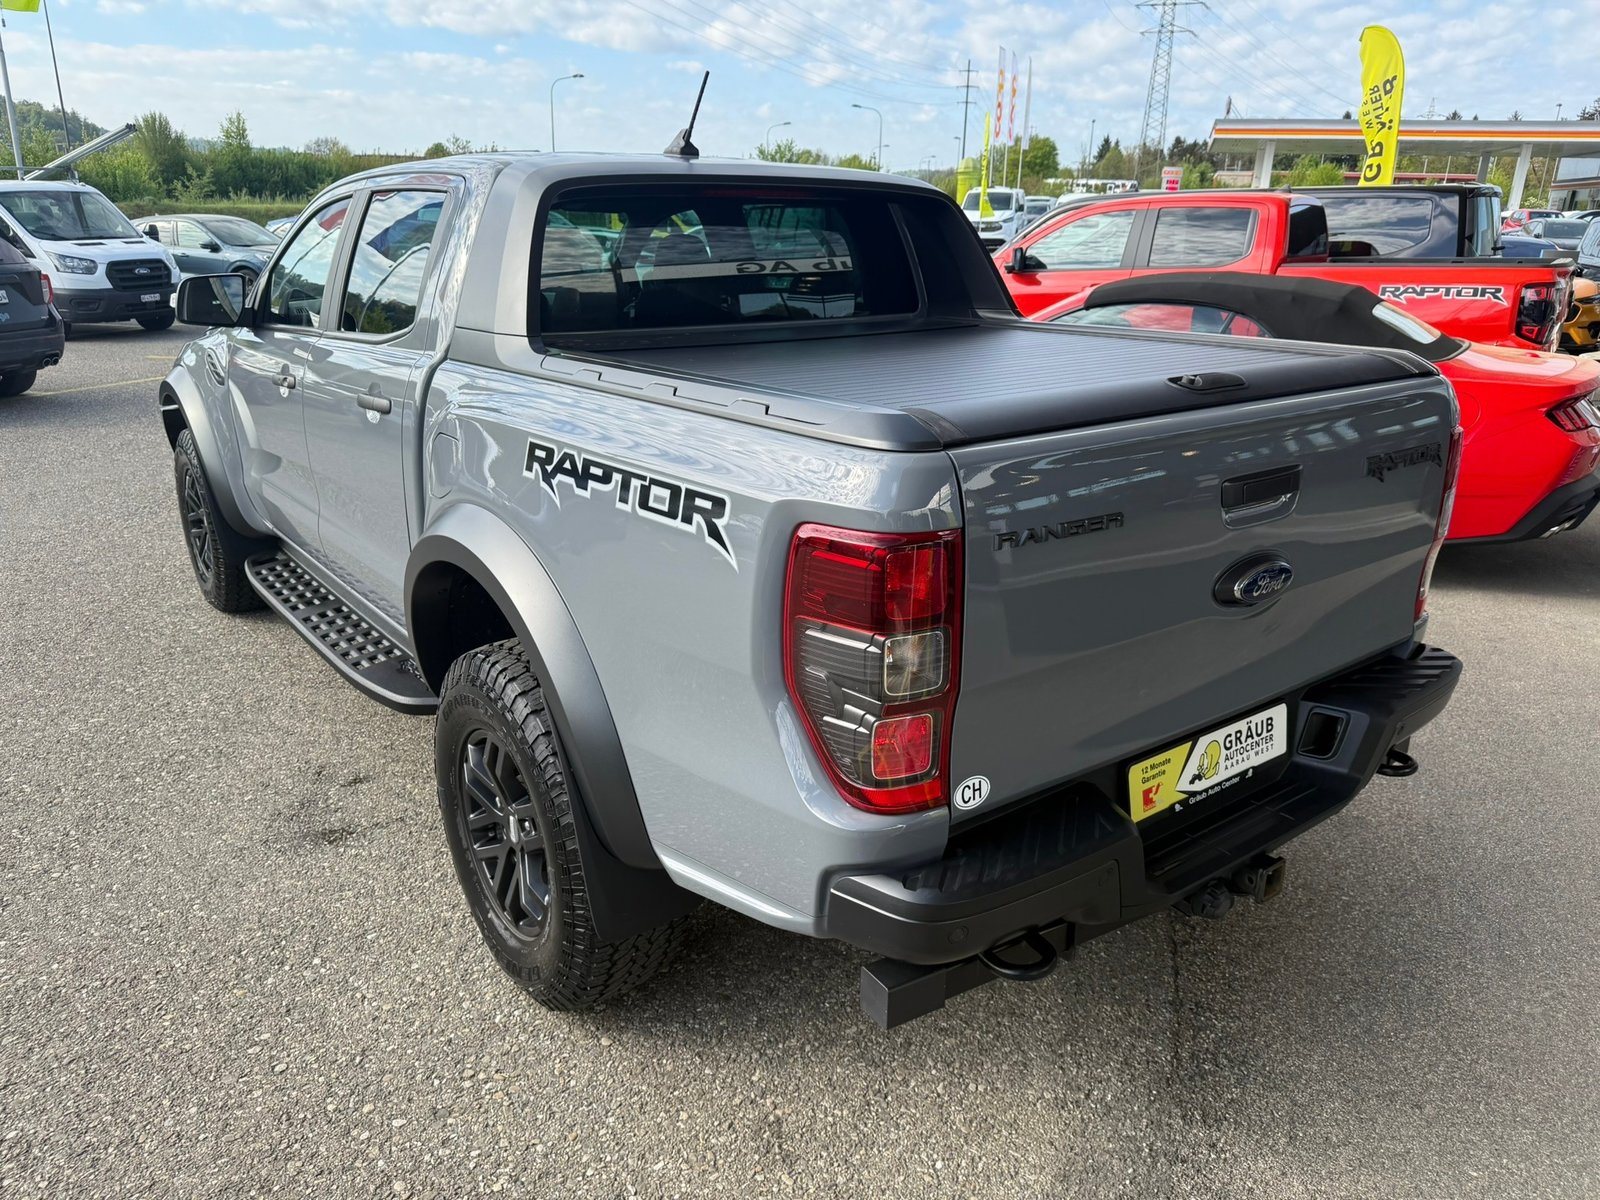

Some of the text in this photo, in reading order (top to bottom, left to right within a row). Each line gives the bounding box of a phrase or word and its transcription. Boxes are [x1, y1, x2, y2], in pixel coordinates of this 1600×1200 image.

[1378, 284, 1508, 307] RAPTOR
[1365, 441, 1443, 483] RAPTOR
[522, 436, 740, 574] RAPTOR
[992, 511, 1125, 552] RANGER
[1252, 572, 1287, 597] Ford
[1223, 716, 1274, 751] GRÄUB
[1224, 733, 1274, 763] AUTOCENTER
[1224, 743, 1274, 771] AARAU WEST
[1141, 757, 1172, 775] 12 Monate
[1141, 769, 1167, 785] Garantie
[961, 780, 982, 804] CH
[1208, 785, 1221, 796] Auto
[1221, 776, 1240, 789] Center
